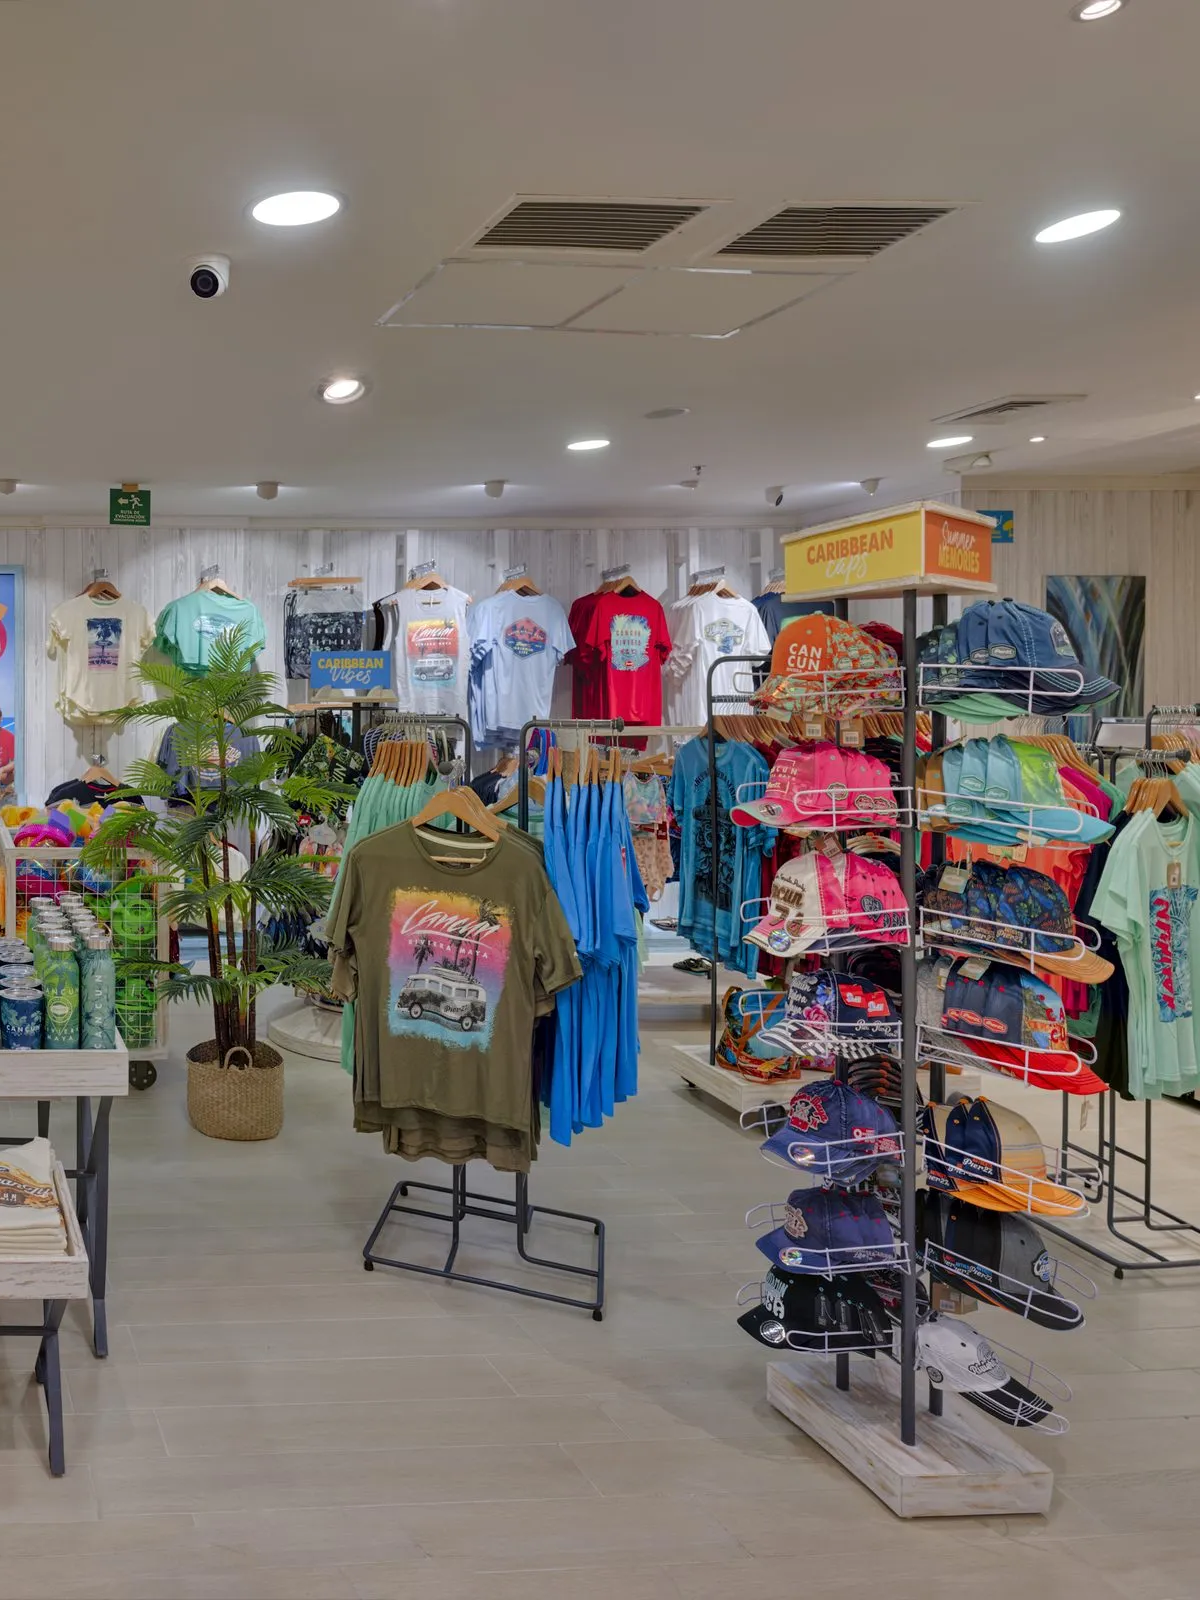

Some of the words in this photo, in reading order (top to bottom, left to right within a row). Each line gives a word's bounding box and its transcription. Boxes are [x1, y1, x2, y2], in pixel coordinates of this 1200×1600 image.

[806, 528, 894, 566] CARIBBEAN
[941, 520, 976, 550] Summer
[825, 551, 869, 585] caps
[937, 544, 980, 574] MEMORIES
[317, 657, 384, 669] CARIBBEAN
[787, 655, 820, 671] CUN
[789, 643, 822, 659] CAN
[329, 667, 372, 684] Vibes
[399, 900, 501, 940] Cancun
[408, 938, 451, 952] RIVIERA
[460, 947, 488, 959] MAYA
[94, 974, 103, 1049] CANCUN
[6, 1025, 40, 1034] CANCUN
